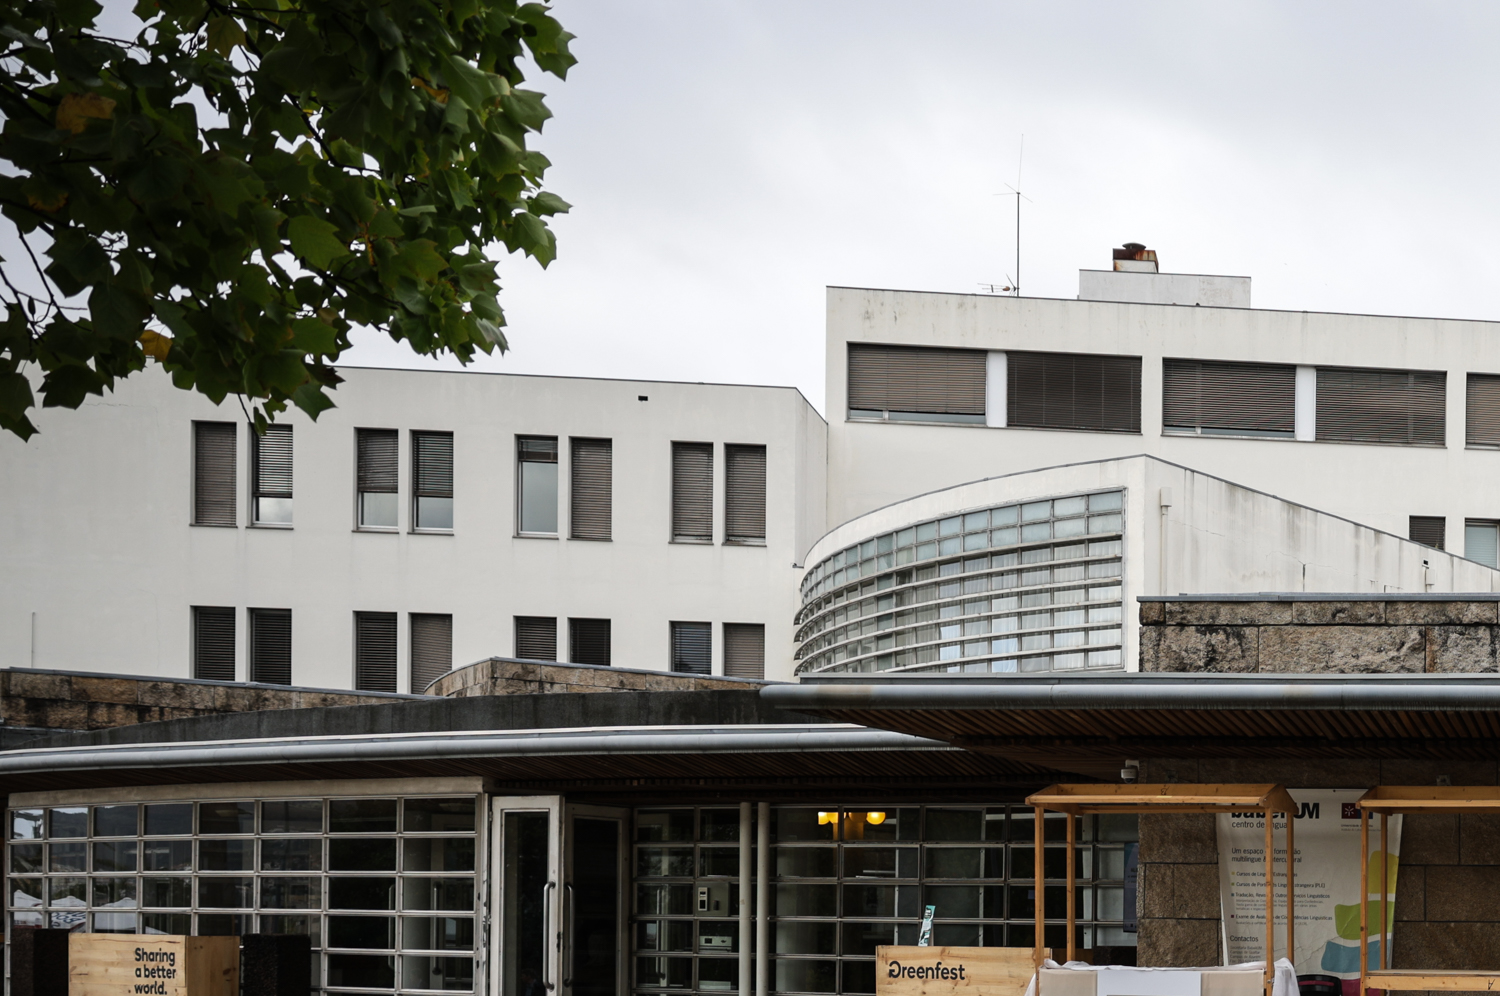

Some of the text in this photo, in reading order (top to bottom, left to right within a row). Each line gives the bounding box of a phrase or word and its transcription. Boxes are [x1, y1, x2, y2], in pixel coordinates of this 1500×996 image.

[135, 947, 175, 967] Sharing
[135, 964, 176, 979] a better
[888, 960, 966, 980] Greenfest
[134, 980, 168, 995] world.
